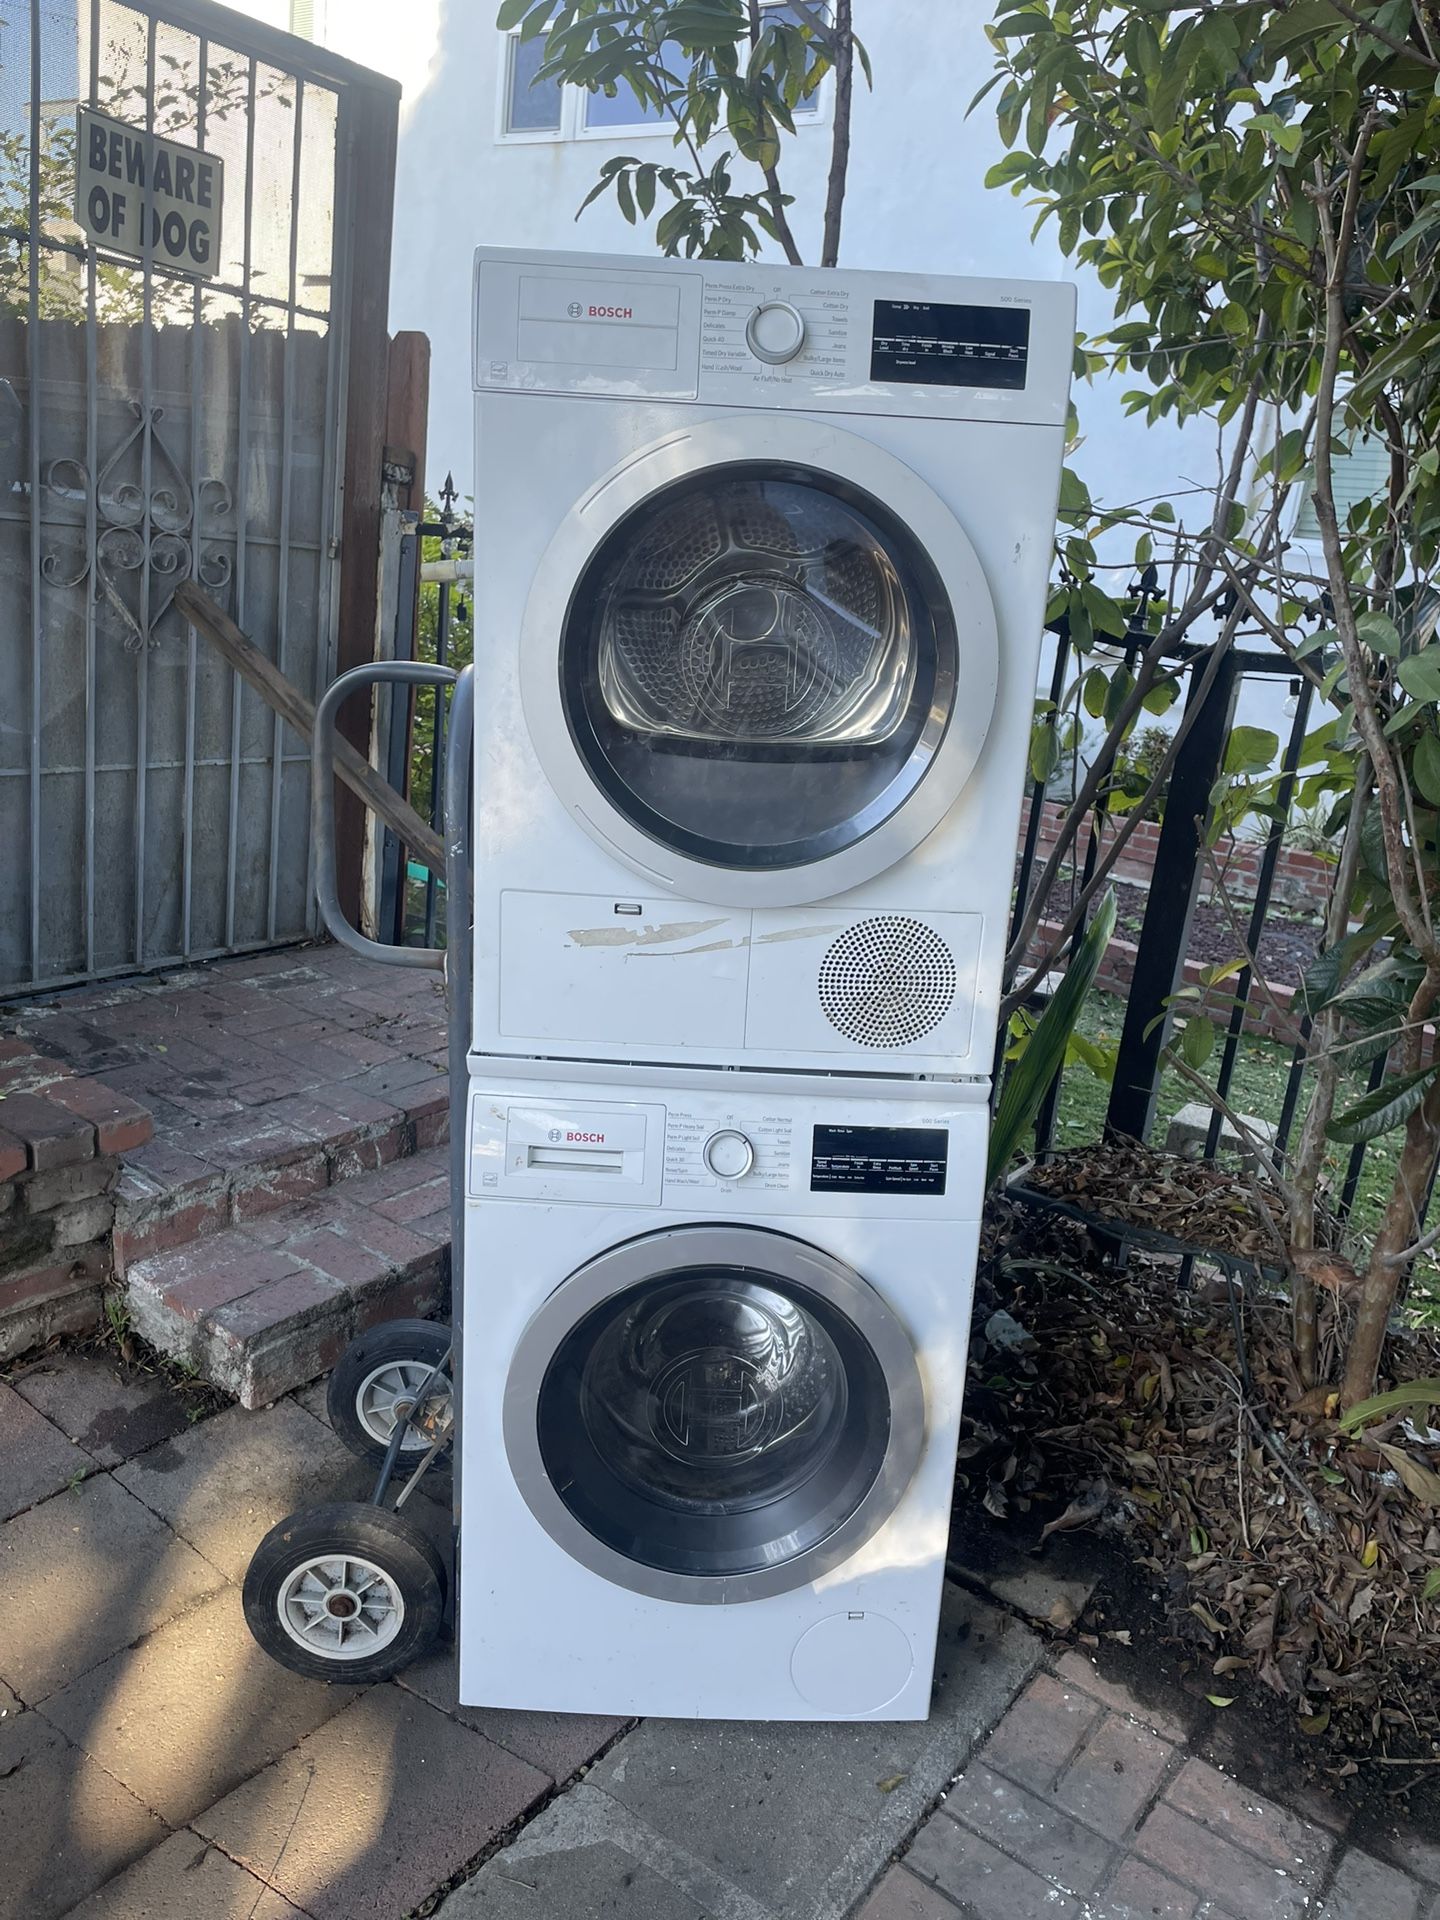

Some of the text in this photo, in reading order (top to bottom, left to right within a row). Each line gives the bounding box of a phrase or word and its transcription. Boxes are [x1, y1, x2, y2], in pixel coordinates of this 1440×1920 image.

[89, 123, 212, 209] BEWARE
[88, 185, 210, 264] OF DOG
[588, 306, 633, 318] BOSCH
[567, 1132, 604, 1143] BOSCH
